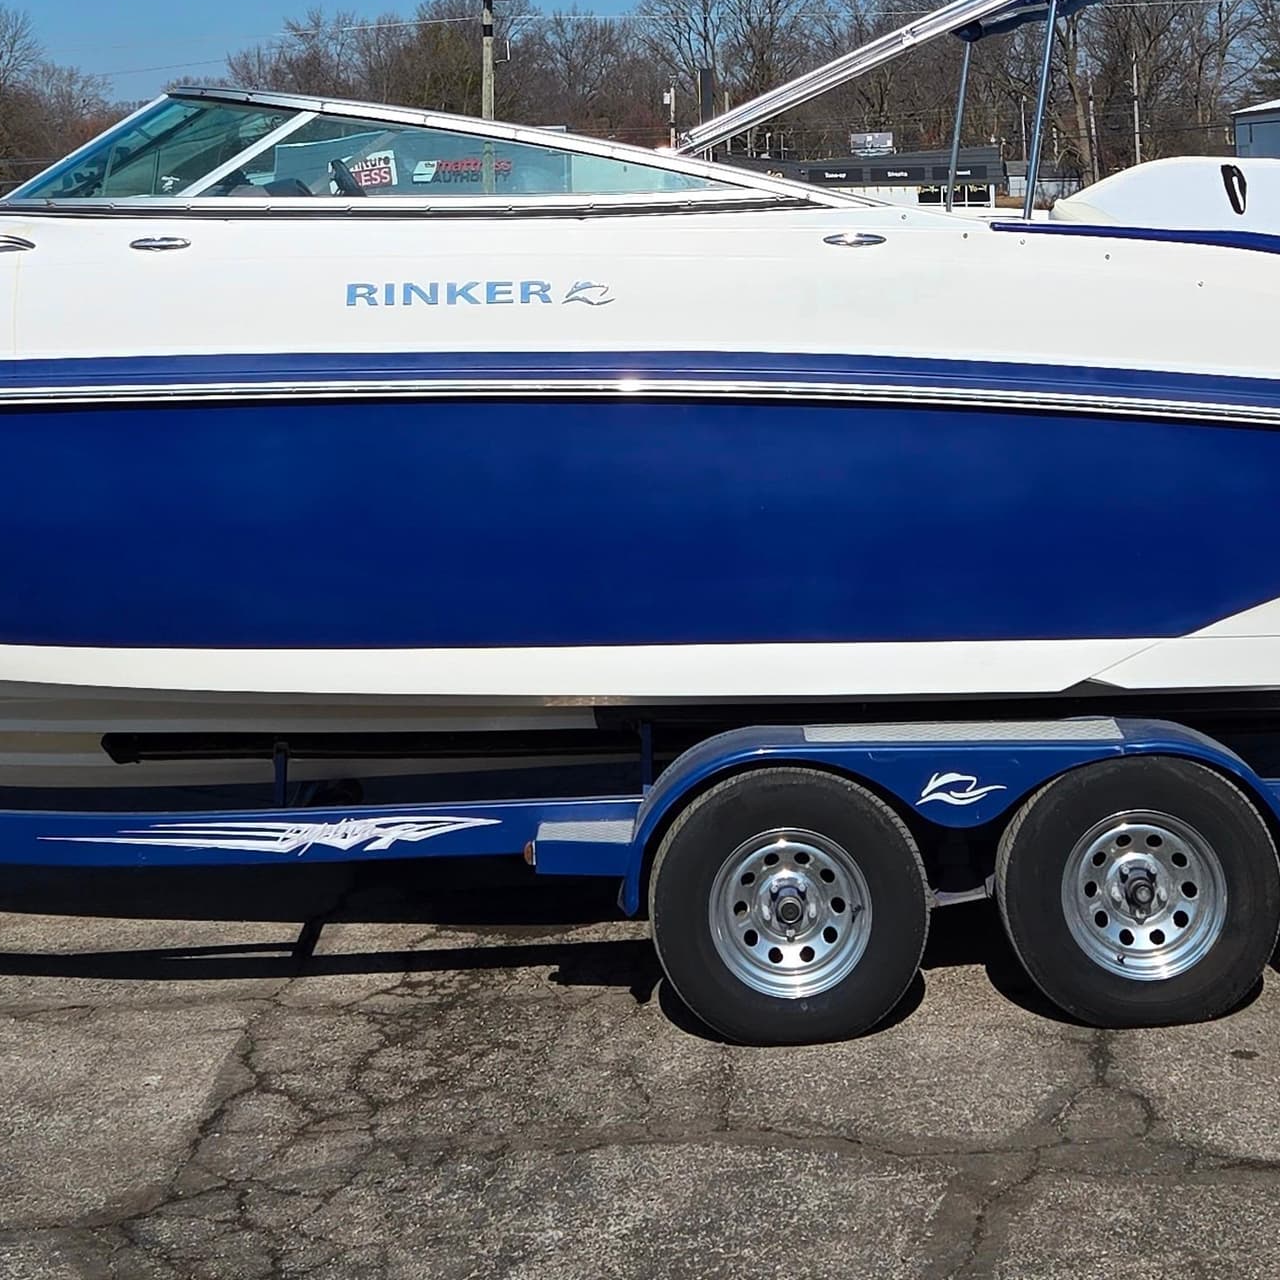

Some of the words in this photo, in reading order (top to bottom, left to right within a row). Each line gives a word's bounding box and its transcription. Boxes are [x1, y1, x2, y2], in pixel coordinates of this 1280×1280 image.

[437, 157, 512, 172] mattrss
[352, 168, 390, 186] ESS
[432, 171, 513, 184] AUTHOTY
[345, 280, 553, 307] RINKER
